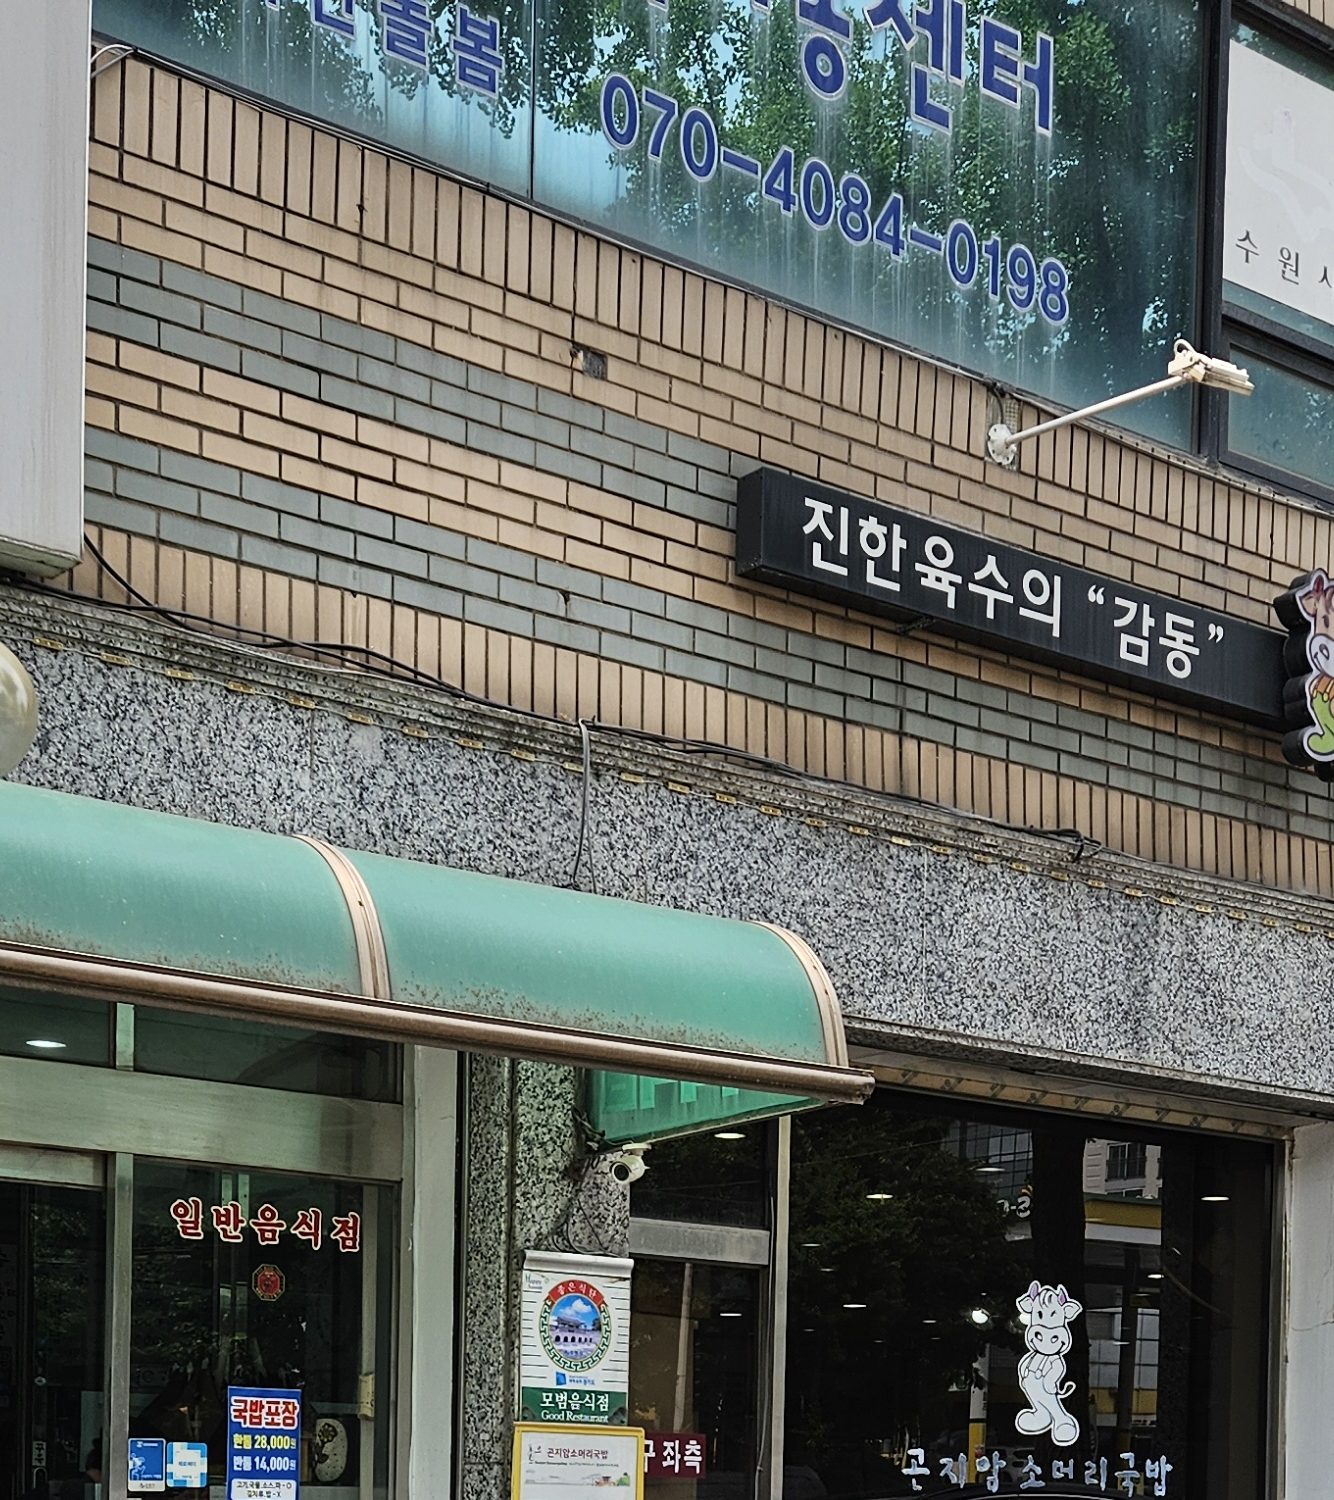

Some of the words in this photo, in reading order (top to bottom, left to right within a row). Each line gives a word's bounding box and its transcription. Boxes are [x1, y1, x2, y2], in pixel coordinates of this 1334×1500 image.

[599, 71, 1070, 326] 070-4084-0198
[170, 1198, 361, 1252] 일반음식점
[231, 1397, 299, 1428] 국밥포장
[540, 1391, 609, 1412] 모범음식점
[541, 1411, 565, 1421] Good
[662, 1439, 703, 1474] 좌측
